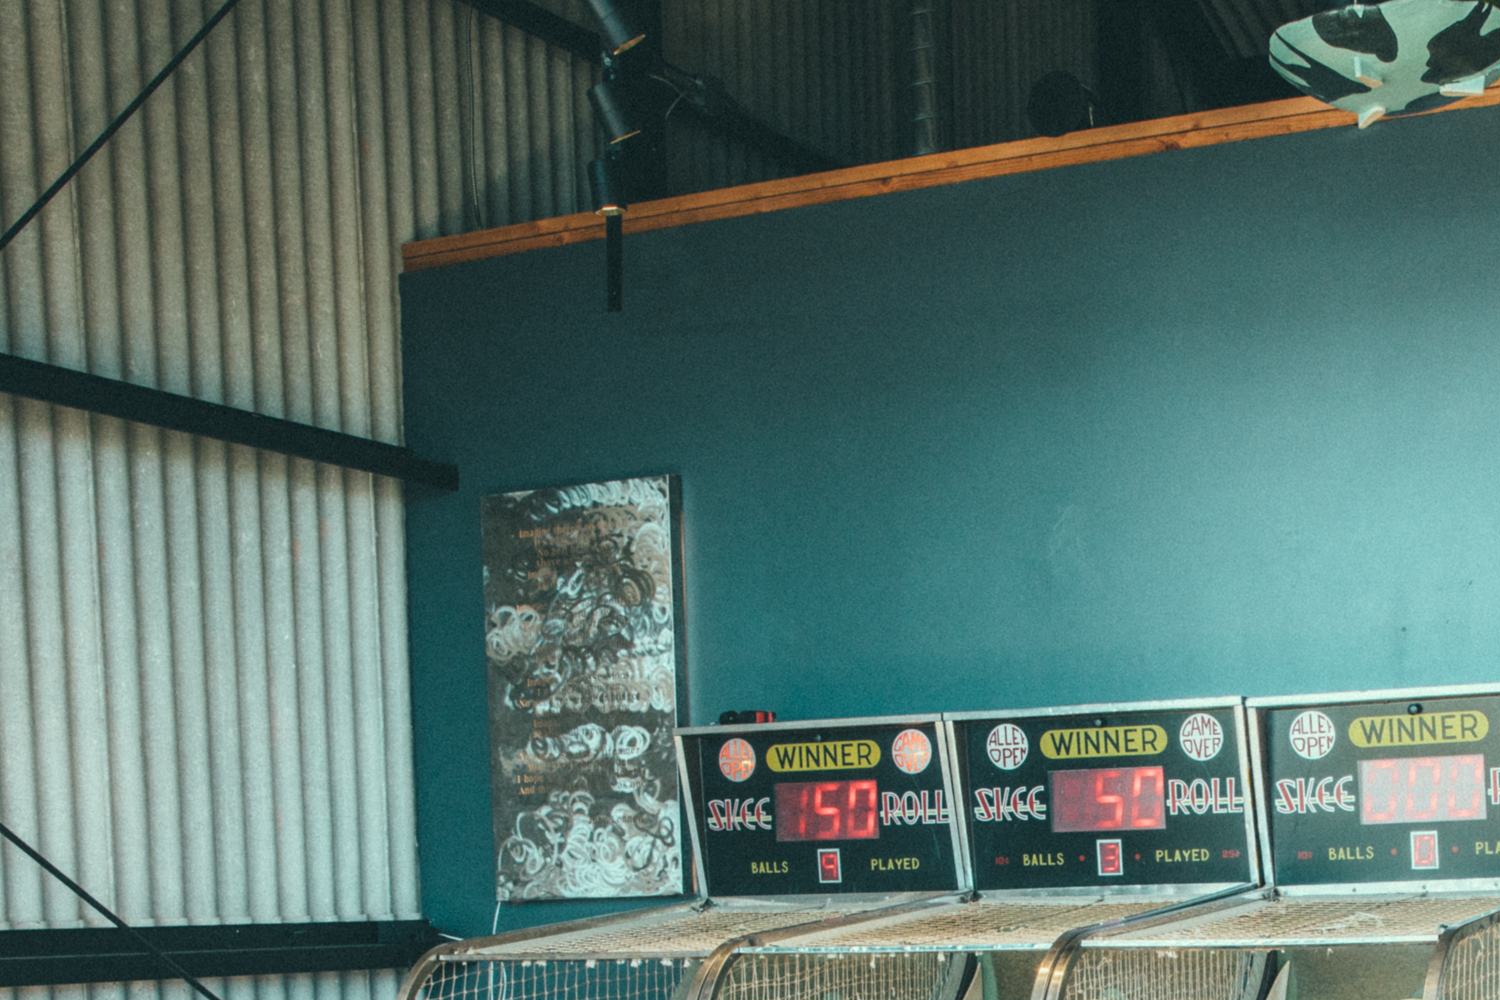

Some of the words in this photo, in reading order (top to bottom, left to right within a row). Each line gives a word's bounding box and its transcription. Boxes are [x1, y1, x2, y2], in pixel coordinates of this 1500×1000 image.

[988, 725, 1026, 746] ALLEY
[1181, 715, 1221, 737] GAME
[1291, 713, 1332, 735] ALLEY
[1359, 713, 1479, 745] WINNER
[719, 739, 756, 761] ALLEY
[894, 731, 931, 752] GAME
[1049, 727, 1158, 756] WINNER
[1182, 737, 1221, 760] OVER
[1292, 735, 1334, 758] OPEN
[775, 742, 873, 769] WINNER
[894, 751, 931, 772] OVER
[989, 746, 1027, 769] OPEN
[720, 760, 756, 781] OPEN
[1095, 767, 1164, 828] 50
[1167, 777, 1244, 816] ROLL
[1275, 775, 1356, 814] SKEE
[1364, 757, 1485, 821] 000
[707, 797, 772, 831] SKEE
[797, 780, 878, 839] 150
[880, 789, 951, 826] ROLL
[974, 785, 1047, 822] SKEE
[1022, 853, 1064, 866] BALLS
[1156, 849, 1210, 863] PLAYED
[1104, 844, 1120, 872] 3
[1328, 846, 1375, 860] BALLS
[1414, 835, 1435, 865] 0
[751, 861, 789, 874] BALLS
[870, 857, 920, 871] PLAYED
[820, 854, 838, 878] 9
